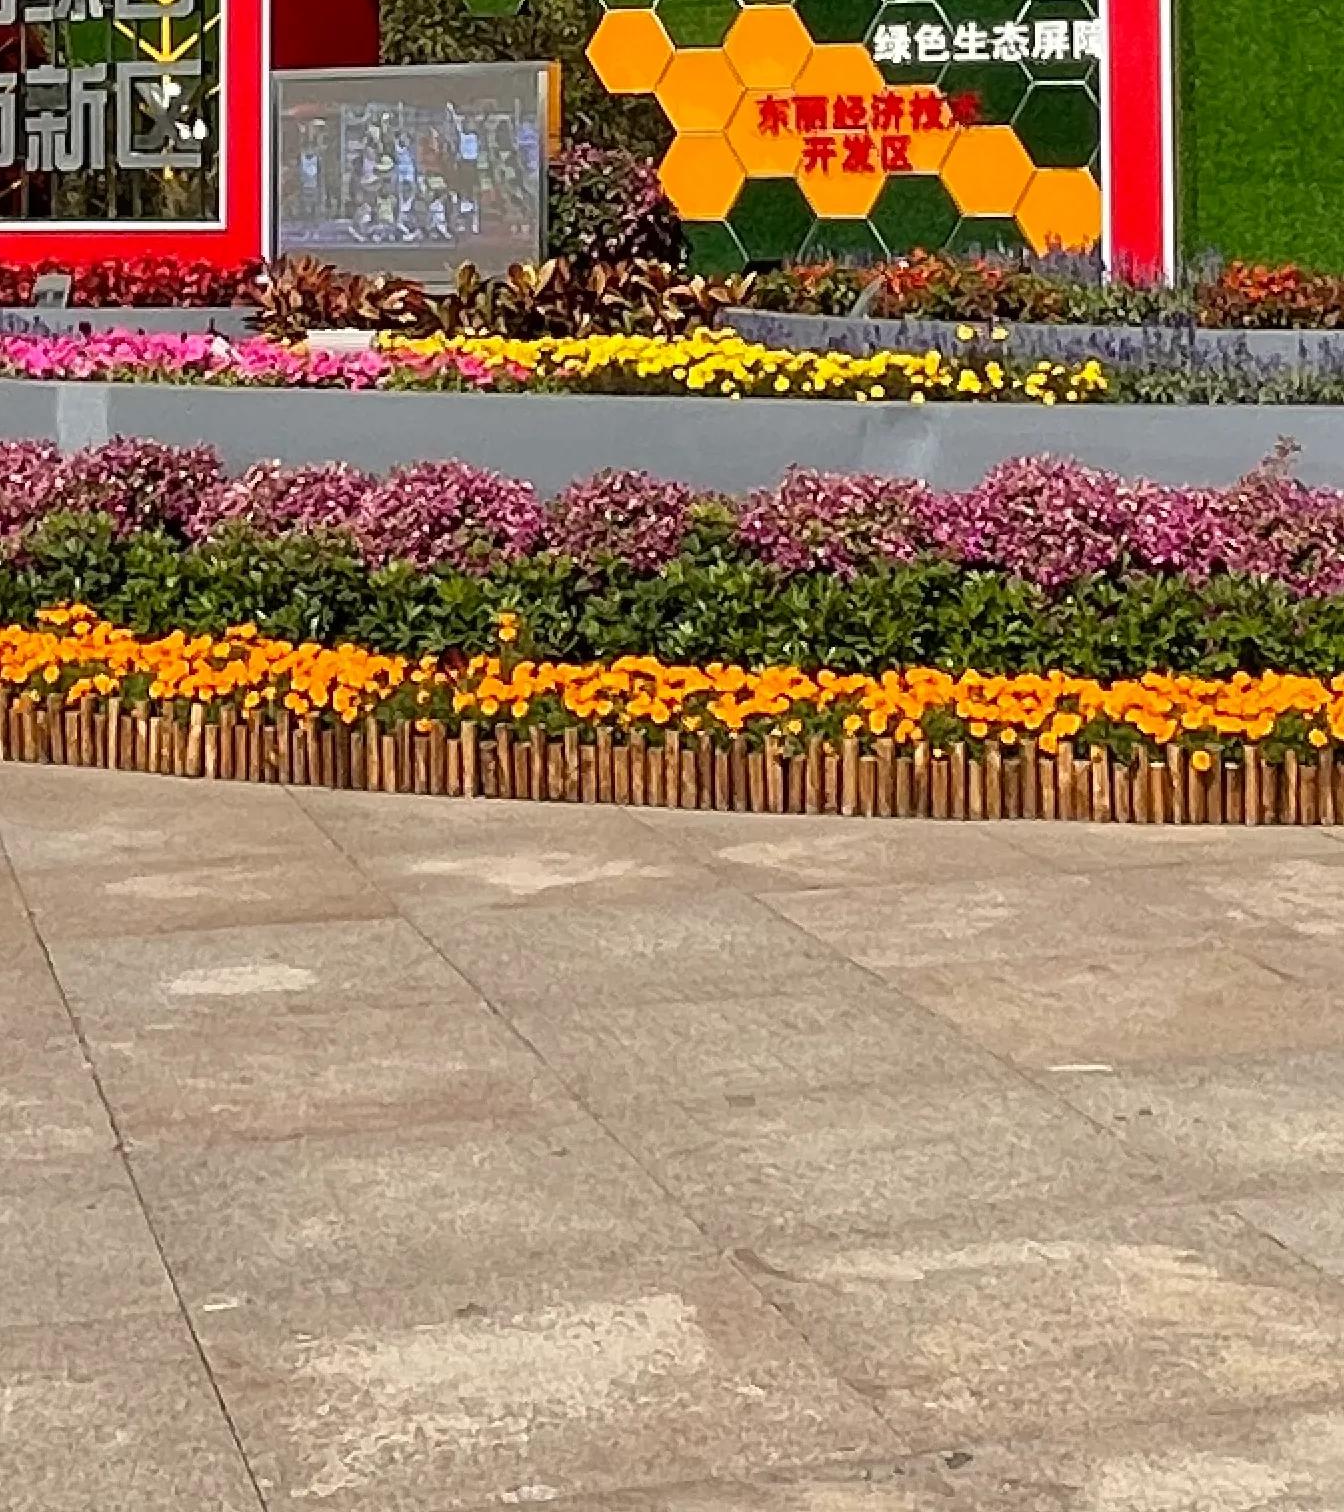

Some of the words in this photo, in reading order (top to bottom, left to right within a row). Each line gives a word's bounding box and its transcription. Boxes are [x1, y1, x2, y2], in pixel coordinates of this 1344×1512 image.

[756, 90, 983, 136] 东丽经济技术
[802, 133, 914, 175] 开发区
